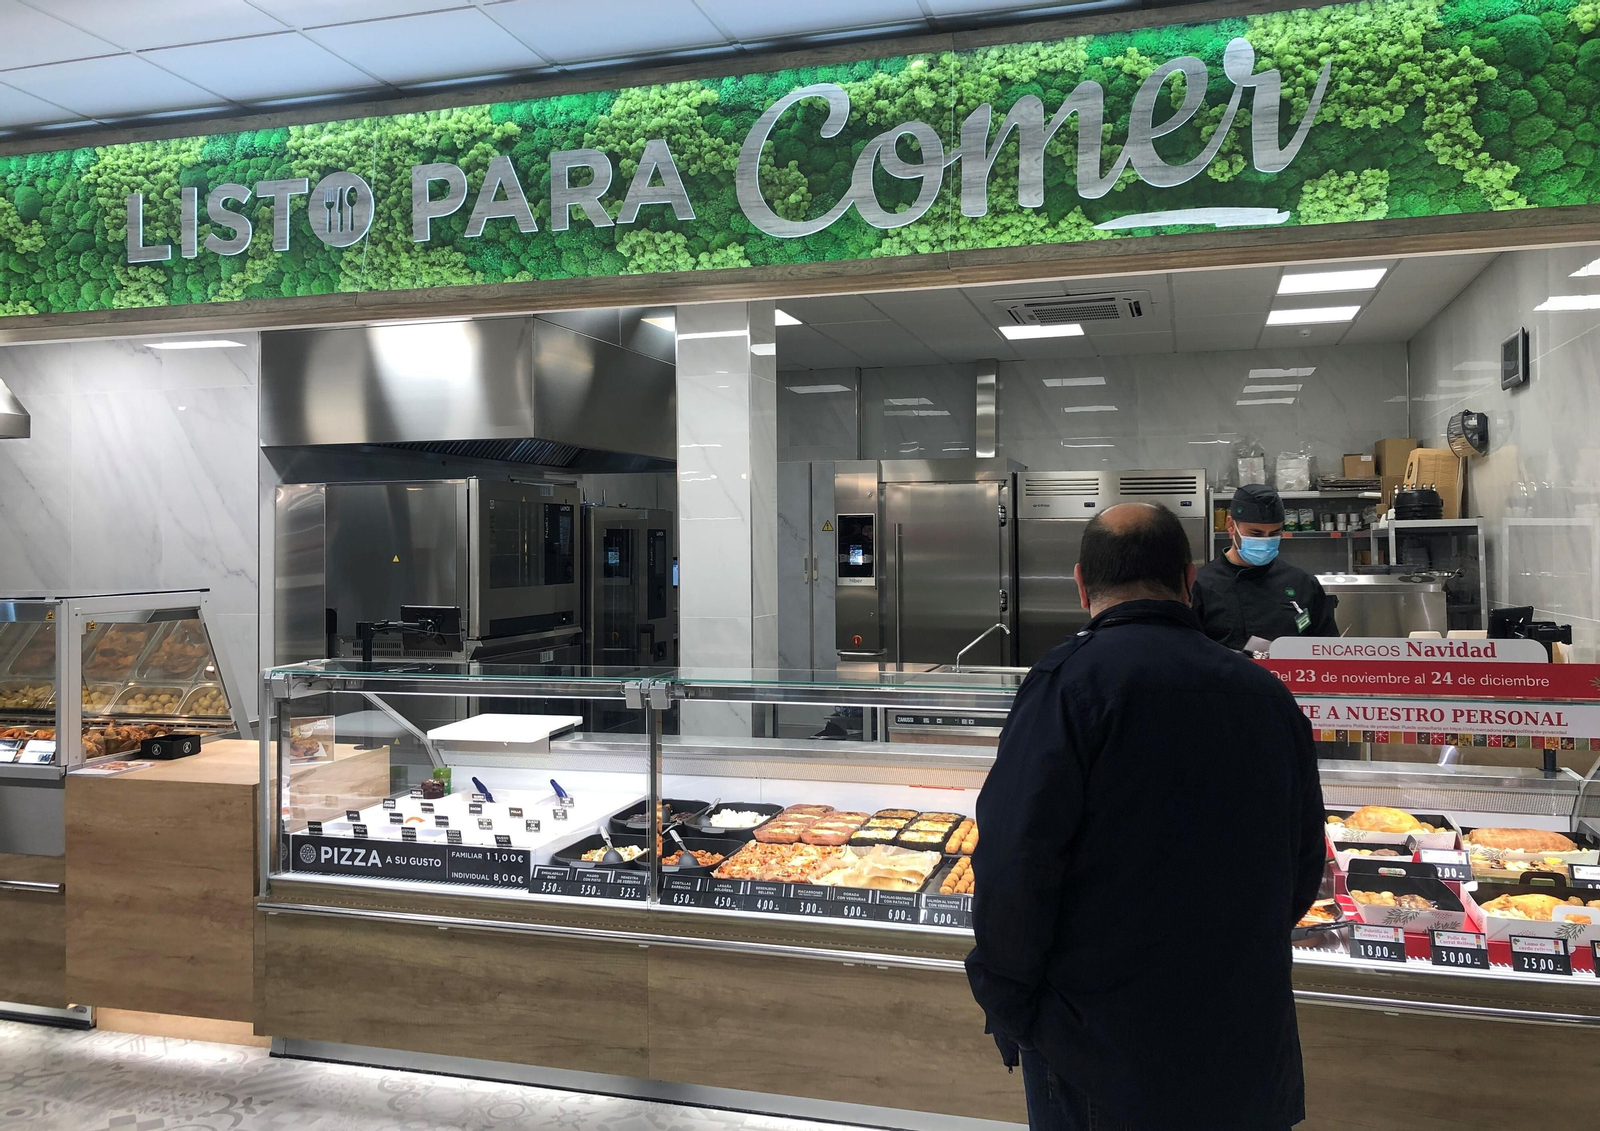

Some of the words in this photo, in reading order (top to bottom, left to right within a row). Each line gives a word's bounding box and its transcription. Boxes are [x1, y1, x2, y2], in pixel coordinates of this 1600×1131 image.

[127, 171, 375, 264] LISTO
[412, 139, 696, 242] PARA
[735, 37, 1332, 239] Comer
[1312, 645, 1400, 657] ENCARGOS
[1406, 641, 1498, 658] Navidad
[1295, 669, 1316, 683] 23
[1321, 671, 1338, 683] de
[1341, 672, 1410, 685] noviembre
[1414, 672, 1425, 684] al
[1431, 671, 1453, 685] 24
[1458, 673, 1475, 686] de
[1480, 674, 1549, 687] diciembre
[1326, 706, 1340, 719] A
[1346, 706, 1445, 722] NUESTRO
[1451, 709, 1569, 726] PERSONAL
[320, 846, 383, 868] PIZZA
[409, 857, 442, 868] GUSTO
[451, 851, 483, 860] FAMILIAR
[451, 872, 490, 881] INDIVIDUAL
[541, 882, 558, 893] 3,50
[580, 884, 596, 896] 3,50
[620, 887, 636, 898] 3,25
[673, 893, 690, 904] 6,50
[714, 896, 731, 907] 4,50
[757, 899, 774, 911] 4,00
[800, 902, 817, 914] 3,00
[844, 905, 861, 917] 6,00
[888, 909, 905, 921] 6,00
[934, 913, 951, 924] 6,00
[1360, 945, 1388, 958] 18,00
[1441, 951, 1471, 964] 30,00
[1523, 957, 1554, 971] 25,00
